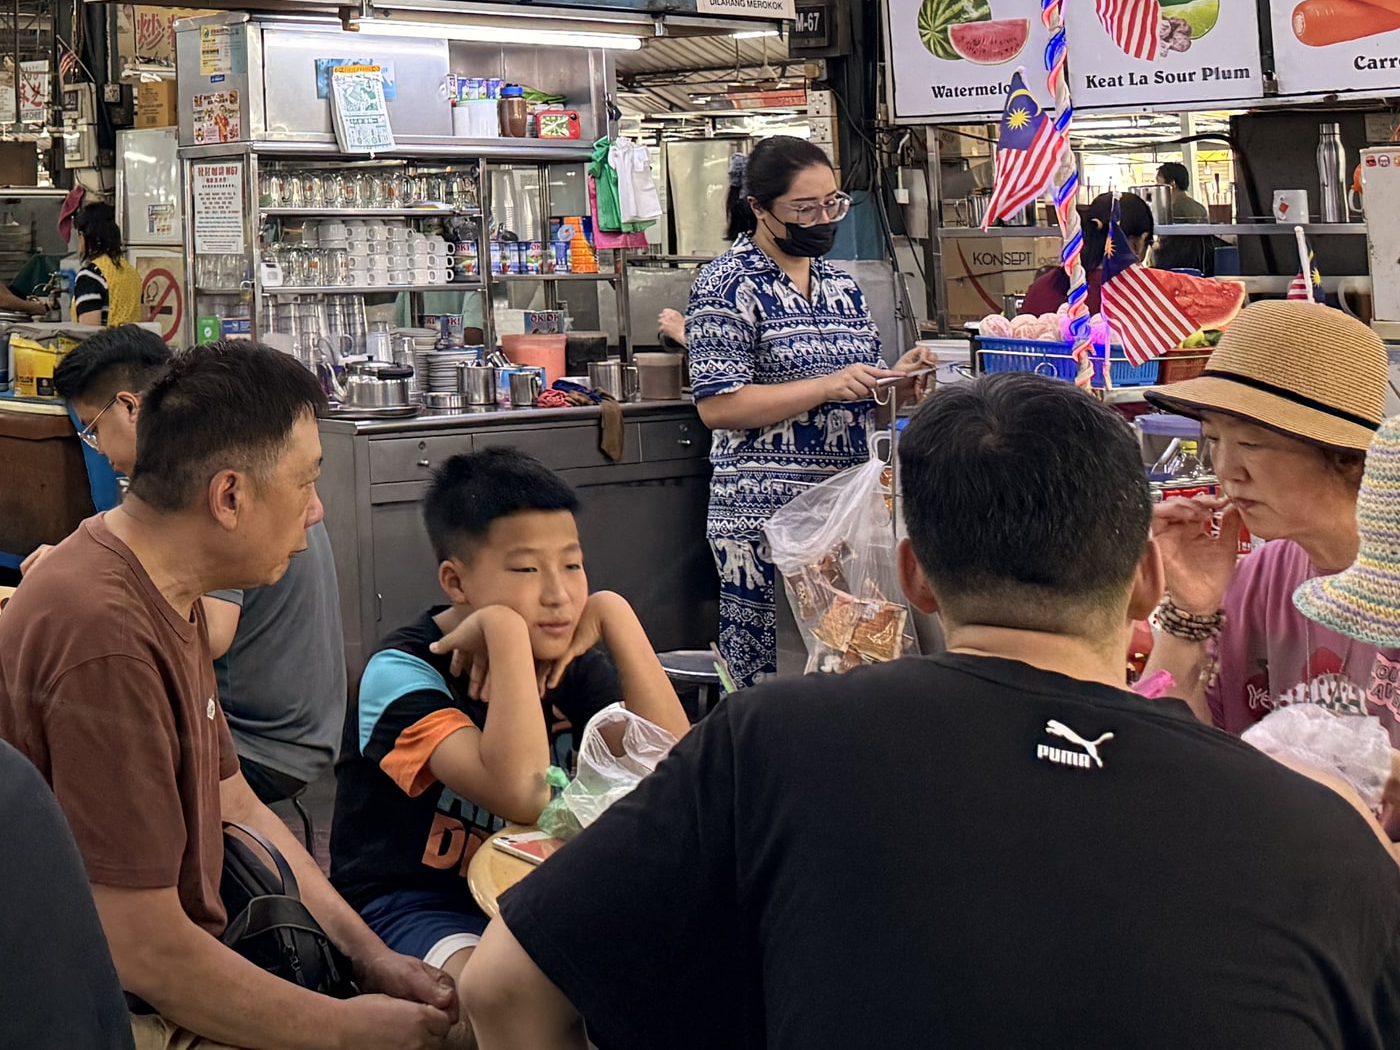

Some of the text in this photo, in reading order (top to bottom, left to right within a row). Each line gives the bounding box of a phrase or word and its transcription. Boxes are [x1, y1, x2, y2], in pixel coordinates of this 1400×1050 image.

[746, 1, 783, 10] MEROKOK
[795, 12, 820, 32] M-67
[1086, 65, 1251, 89] Keat La Sour Plum
[931, 81, 1011, 99] Watermelo
[972, 252, 1032, 266] KONSEPT
[1037, 744, 1090, 768] PUMA
